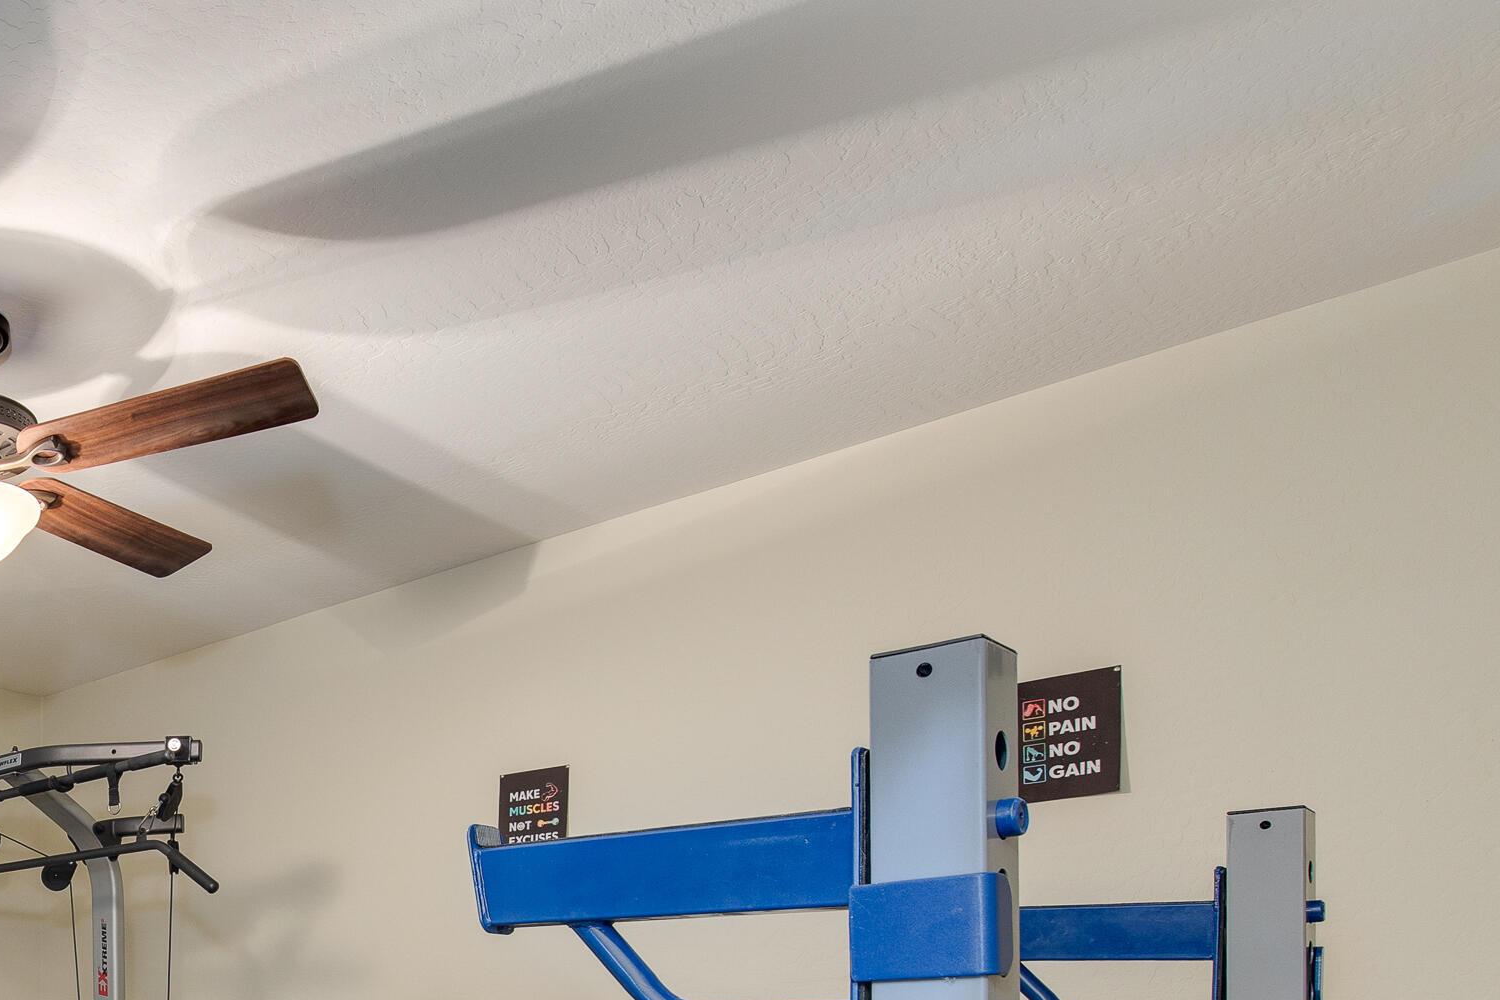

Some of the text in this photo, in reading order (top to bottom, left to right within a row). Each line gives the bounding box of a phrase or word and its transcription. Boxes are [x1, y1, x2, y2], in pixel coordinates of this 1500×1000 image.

[1048, 696, 1080, 714] NO
[1048, 715, 1096, 736] PAIN
[1048, 741, 1080, 758] NO
[1048, 759, 1101, 779] GAIN
[509, 788, 541, 803] MAKE
[509, 801, 560, 817] MUSCLES
[508, 820, 532, 832] NOT
[508, 831, 559, 845] EXCUSES
